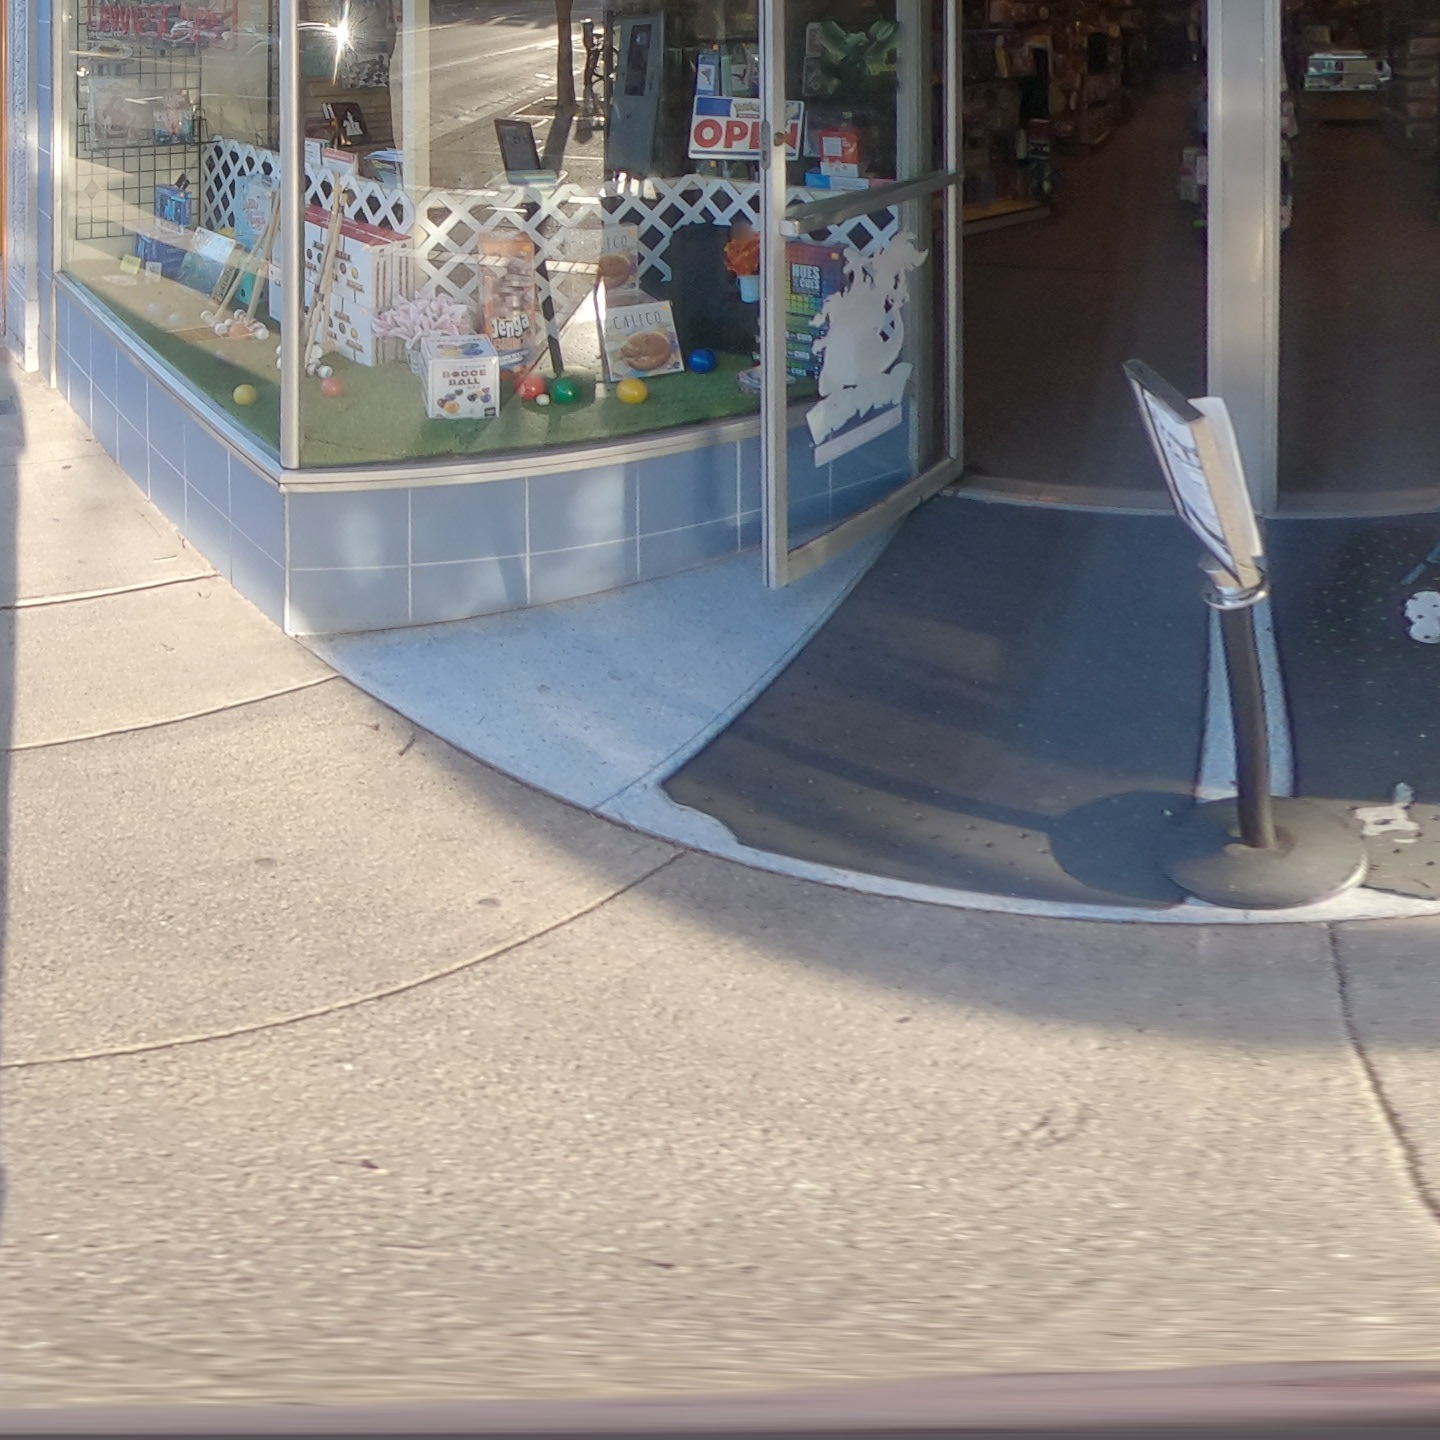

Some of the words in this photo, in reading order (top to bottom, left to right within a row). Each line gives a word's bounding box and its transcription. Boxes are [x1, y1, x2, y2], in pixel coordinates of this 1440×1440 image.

[791, 263, 820, 279] HUES
[491, 313, 530, 339] Jenga
[612, 310, 662, 330] CALICO
[442, 368, 487, 379] BOCCE
[448, 377, 481, 386] BALL
